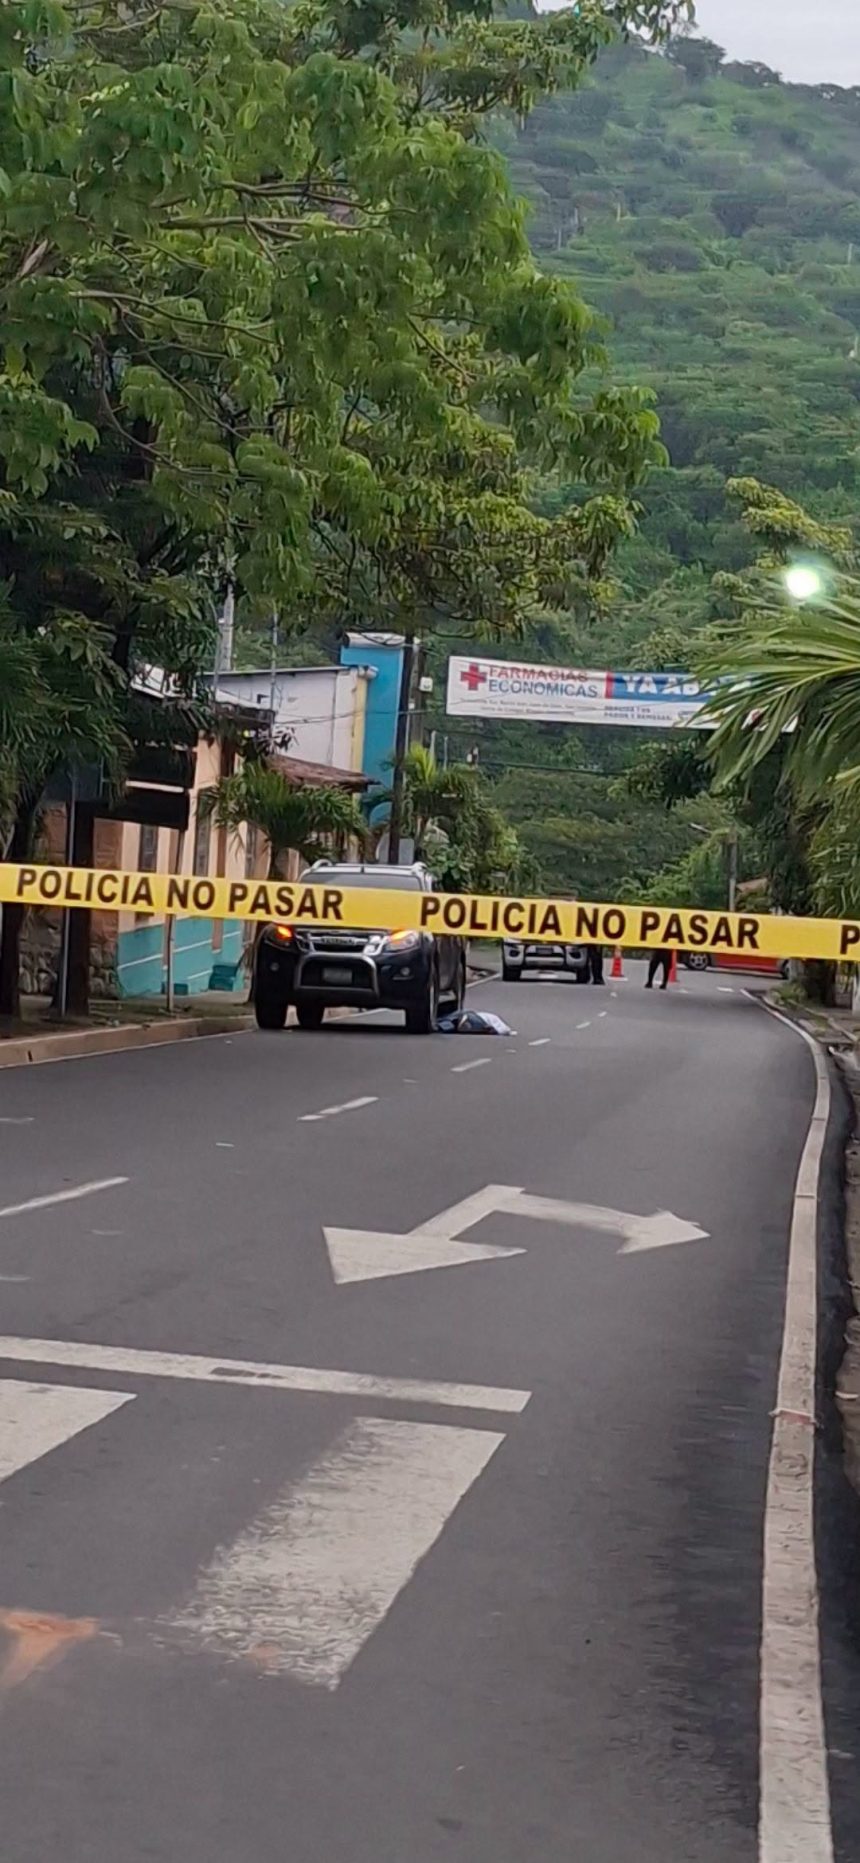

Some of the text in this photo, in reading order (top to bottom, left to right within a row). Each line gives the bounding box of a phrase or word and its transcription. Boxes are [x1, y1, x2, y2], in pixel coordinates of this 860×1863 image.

[489, 666, 588, 682] FARMACIAS
[623, 675, 658, 694] YA
[17, 868, 343, 920] POLICIA NO PASAR
[420, 897, 759, 949] POLICIA NO PASAR
